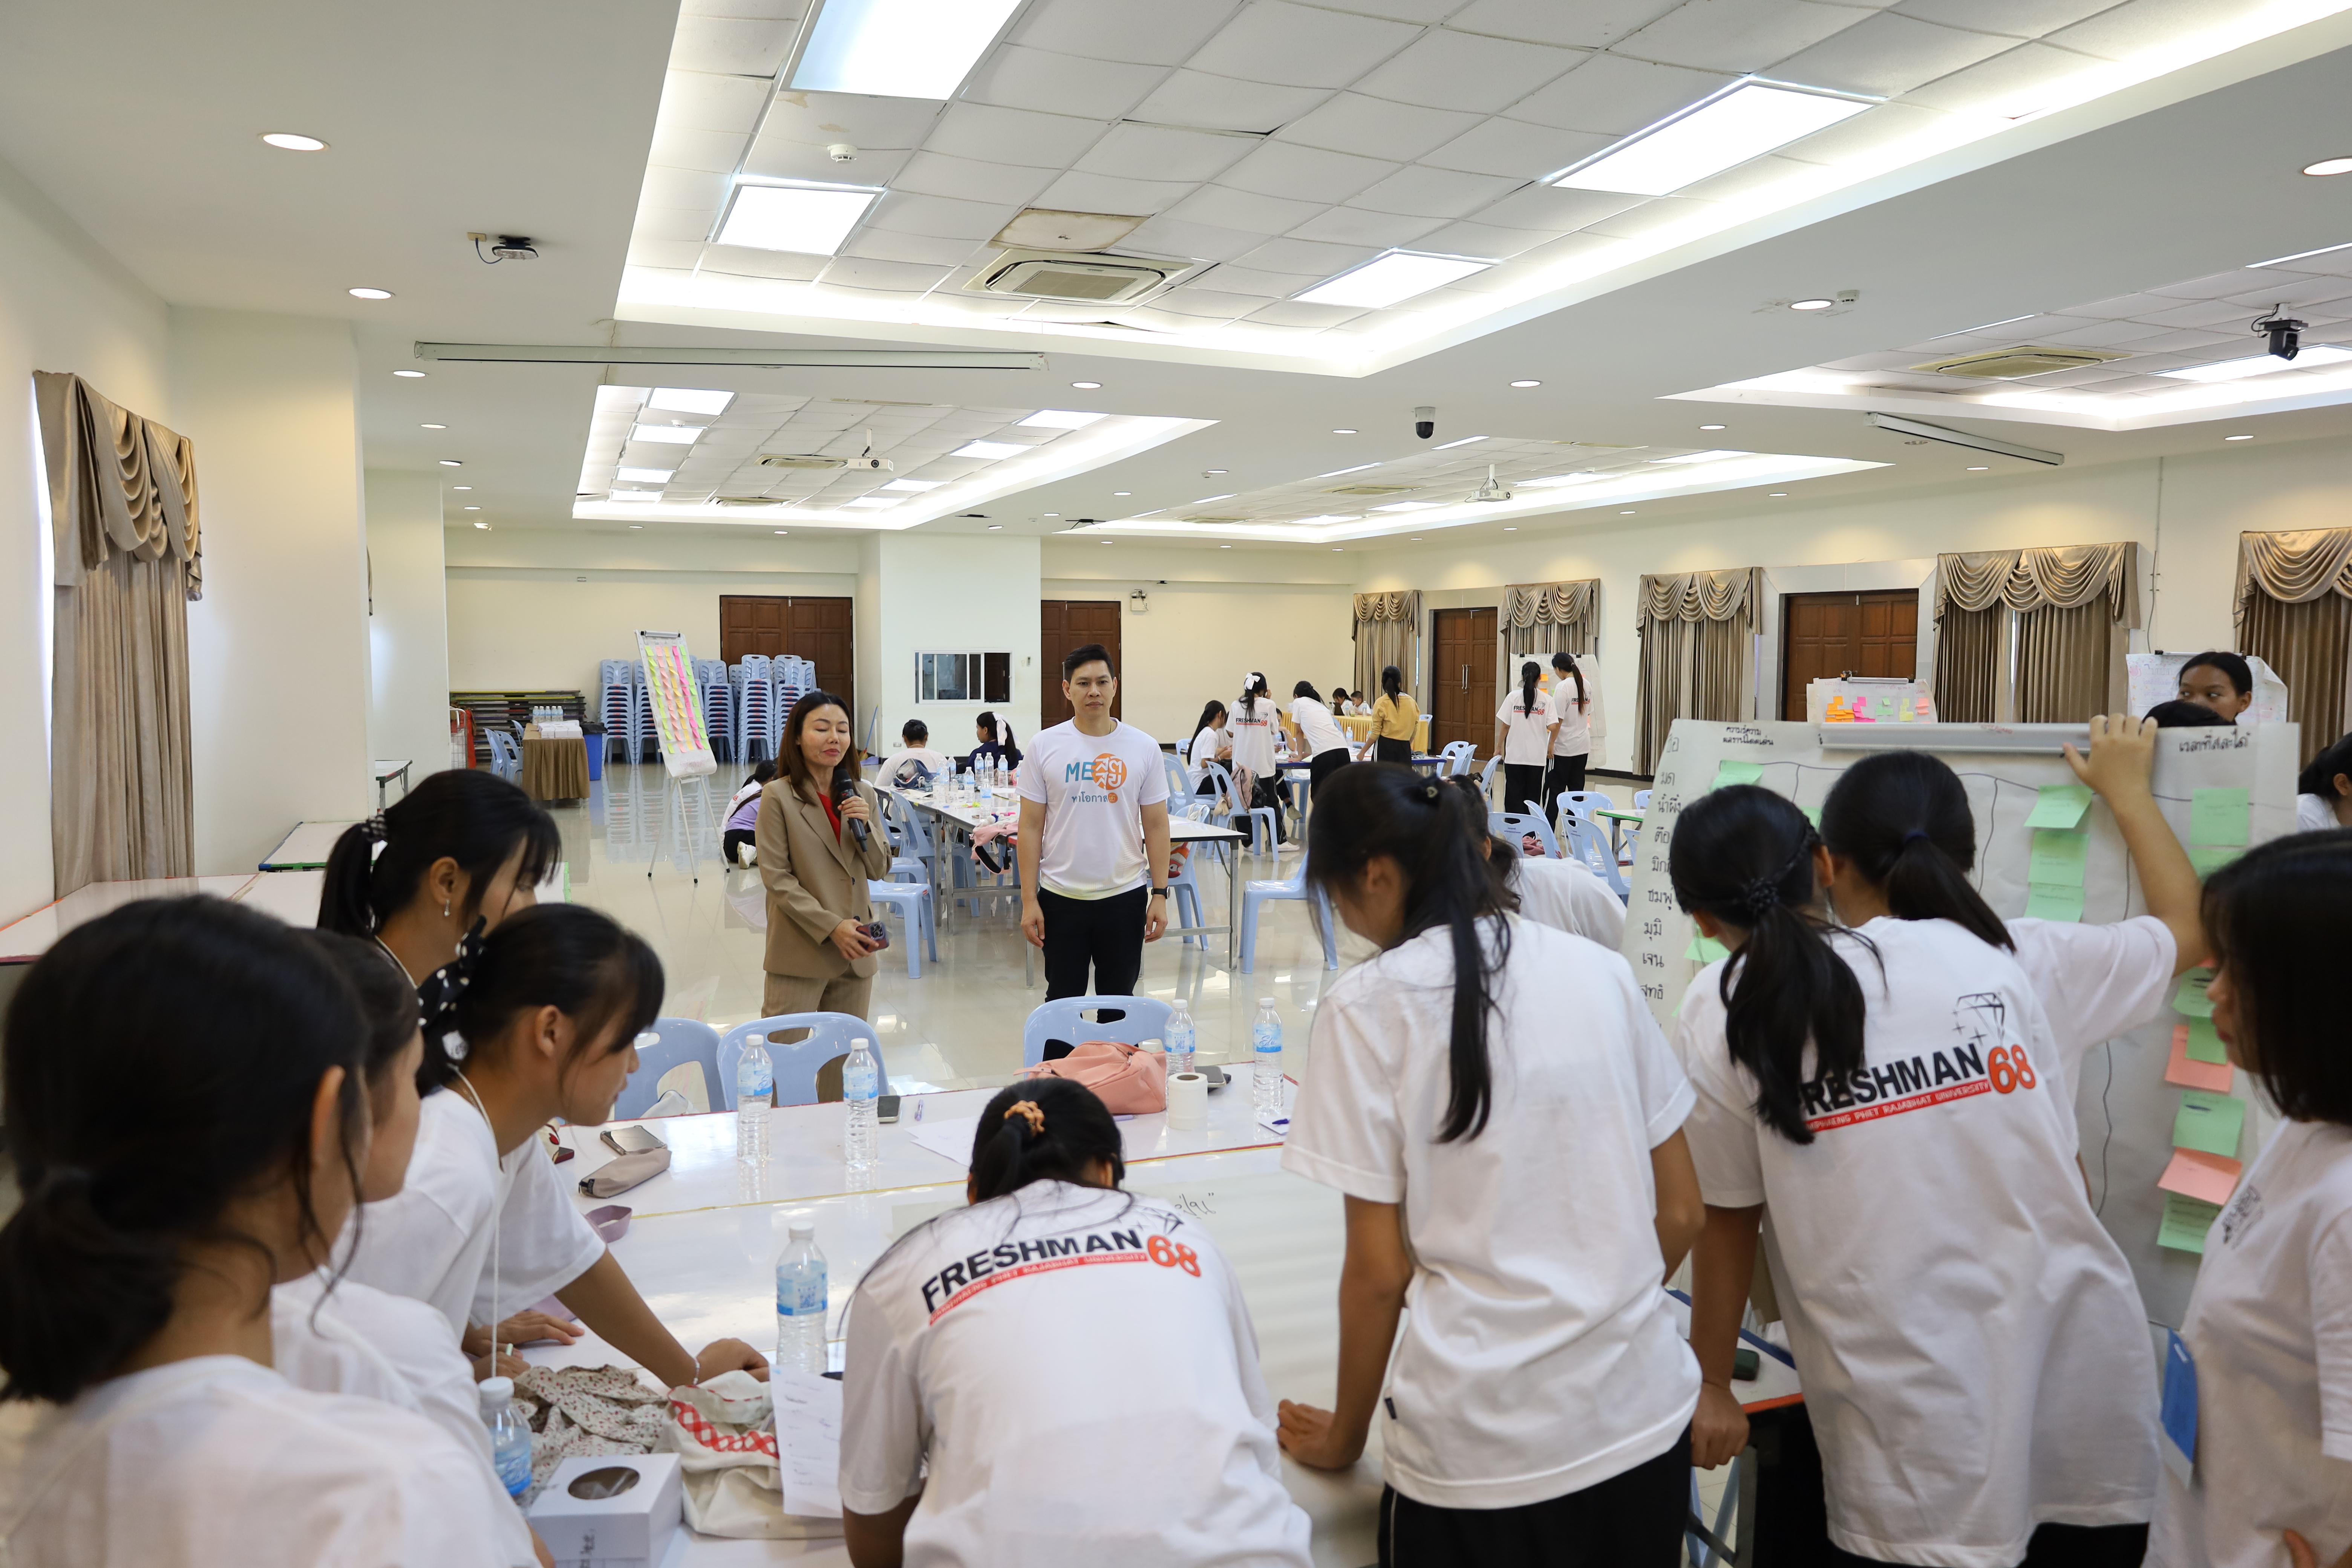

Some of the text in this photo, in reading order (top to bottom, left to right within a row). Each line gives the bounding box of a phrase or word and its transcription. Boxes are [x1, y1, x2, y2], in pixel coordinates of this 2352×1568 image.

[1065, 761, 1096, 783] ME
[1643, 952, 1664, 968] เจน
[1800, 1043, 2036, 1116] RESHMAN 68
[1853, 1107, 1879, 1120] PHET
[1882, 1095, 1932, 1114] RAJABHAT
[1935, 1081, 1989, 1101] UNIVERSITY
[922, 1229, 1201, 1314] FRESHMAN 68
